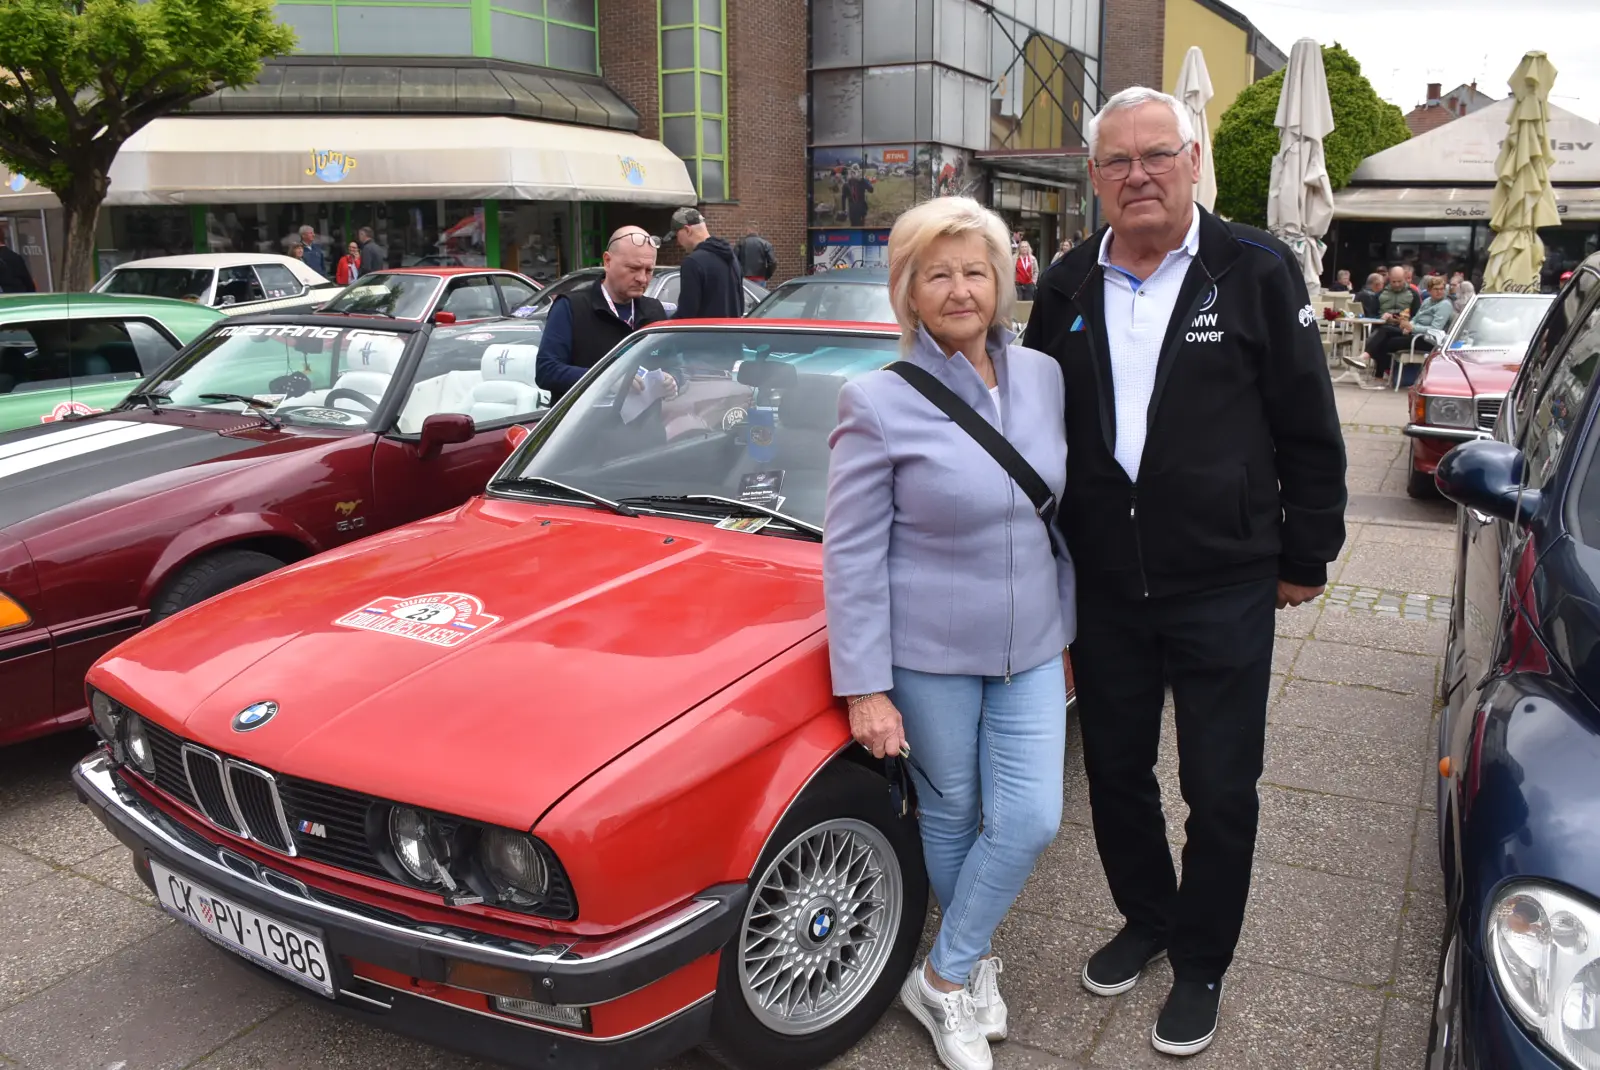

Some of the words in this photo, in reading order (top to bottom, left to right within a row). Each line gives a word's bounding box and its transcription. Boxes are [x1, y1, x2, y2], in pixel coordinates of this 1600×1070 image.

[1191, 313, 1219, 328] MW
[214, 325, 344, 339] MUSTANG
[1185, 331, 1224, 343] ower
[336, 516, 365, 531] 5.0
[405, 608, 440, 621] 23
[211, 897, 326, 983] PV-1986
